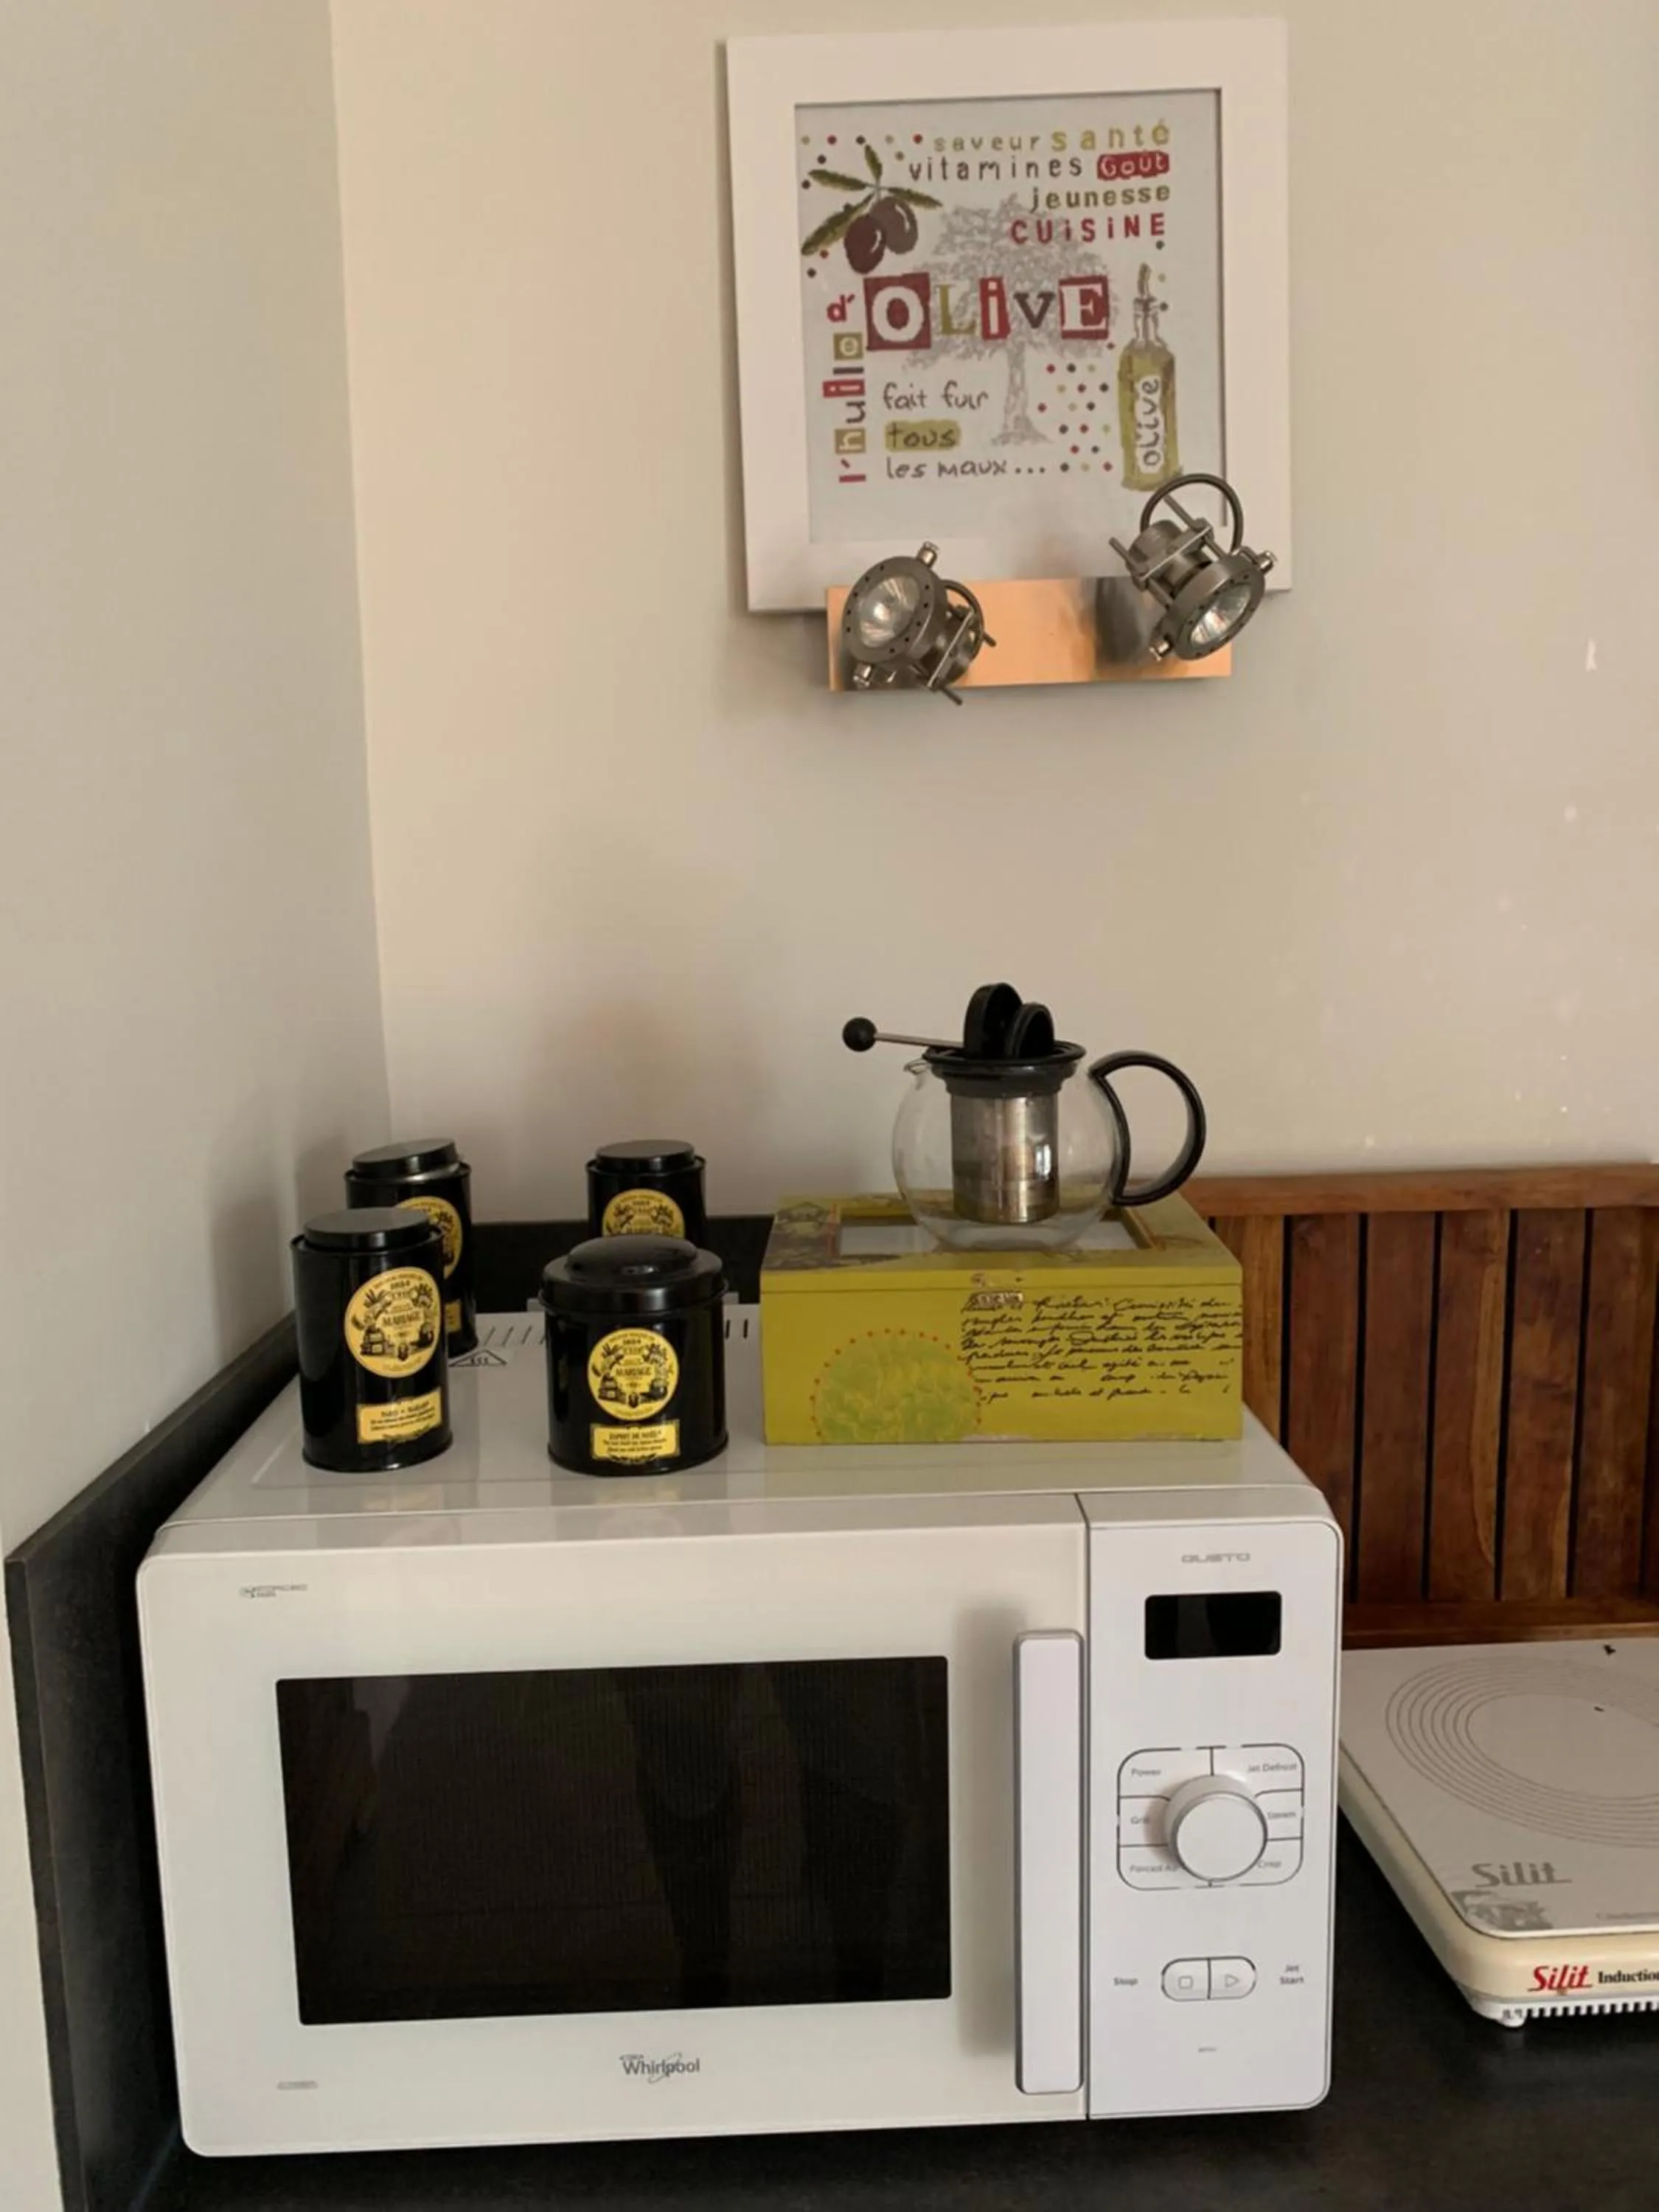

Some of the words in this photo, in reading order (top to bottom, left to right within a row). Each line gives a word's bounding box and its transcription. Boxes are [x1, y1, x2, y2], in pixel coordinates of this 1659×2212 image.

[933, 135, 1040, 152] saveur
[1051, 118, 1170, 152] santé
[908, 155, 1082, 182] vitamines
[1029, 184, 1171, 213] jeunesse
[883, 380, 928, 410] fait
[886, 421, 957, 449] tous
[886, 456, 928, 479] les
[1131, 1767, 1162, 1777] Power
[1471, 1861, 1573, 1888] Silit
[1113, 1976, 1138, 1987] Stop
[1279, 1975, 1305, 1986] Start
[1527, 1964, 1593, 1992] Silit
[621, 2055, 700, 2081] Whirlpool
